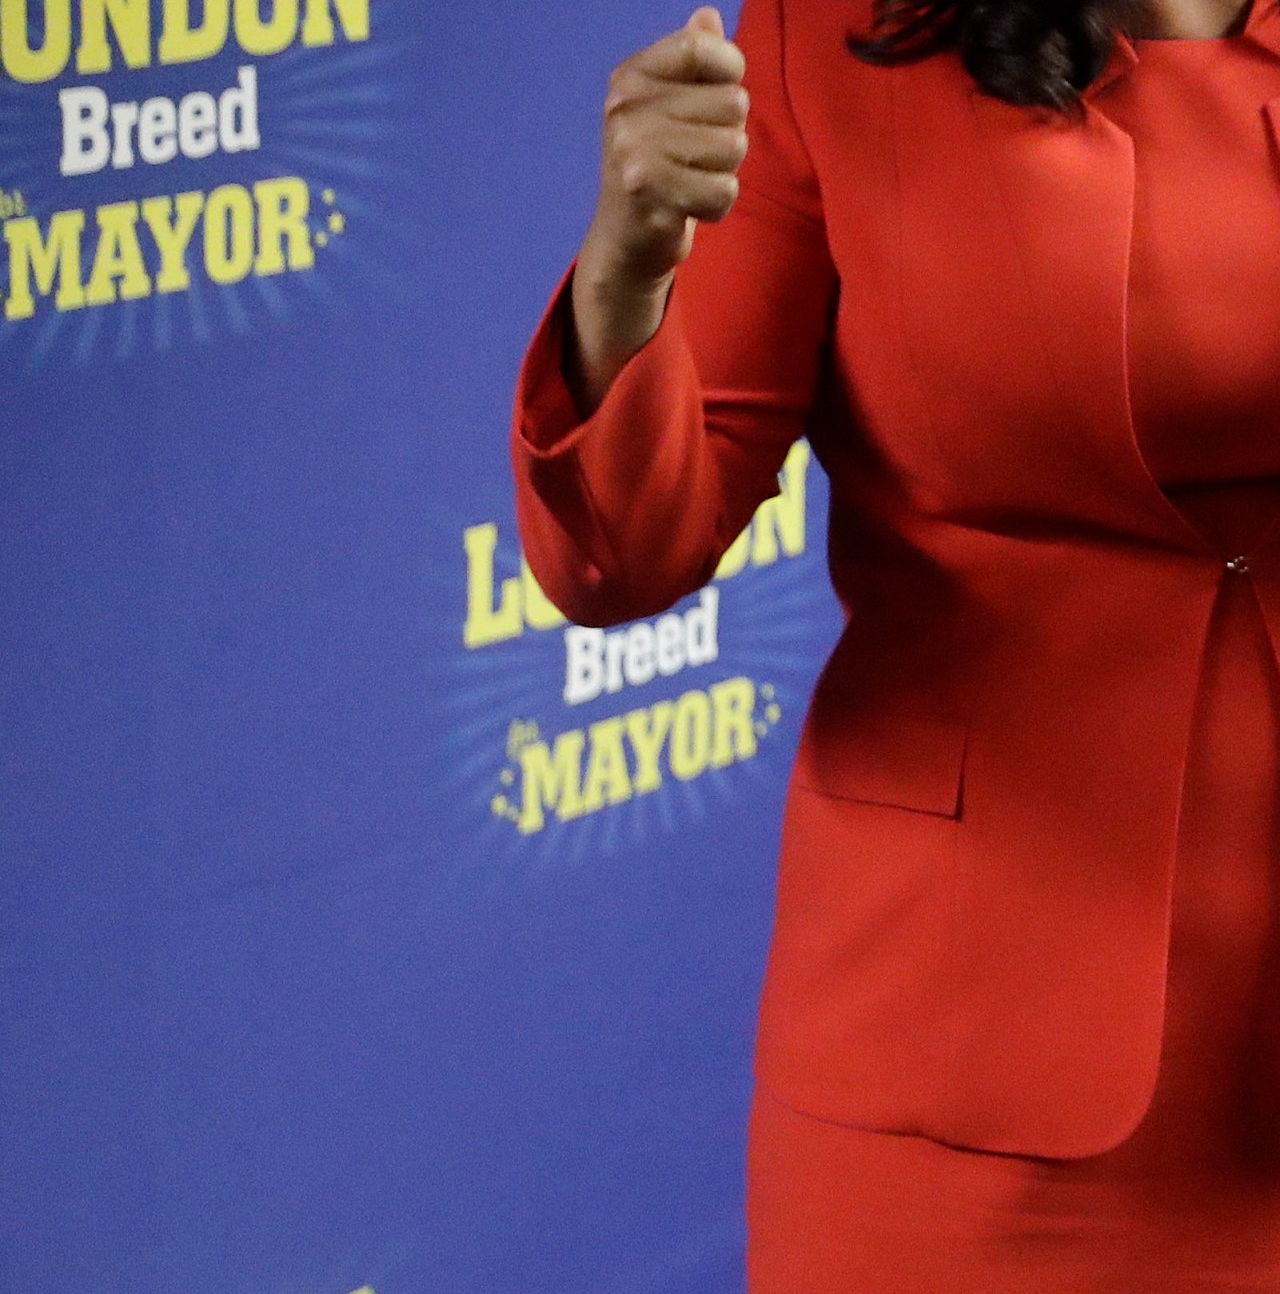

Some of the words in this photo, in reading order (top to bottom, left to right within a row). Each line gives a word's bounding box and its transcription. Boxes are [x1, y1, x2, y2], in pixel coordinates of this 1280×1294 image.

[58, 63, 261, 177] Breed
[2, 176, 316, 321] MAYOR
[563, 585, 720, 705] Breed
[518, 676, 758, 835] MAYOR
